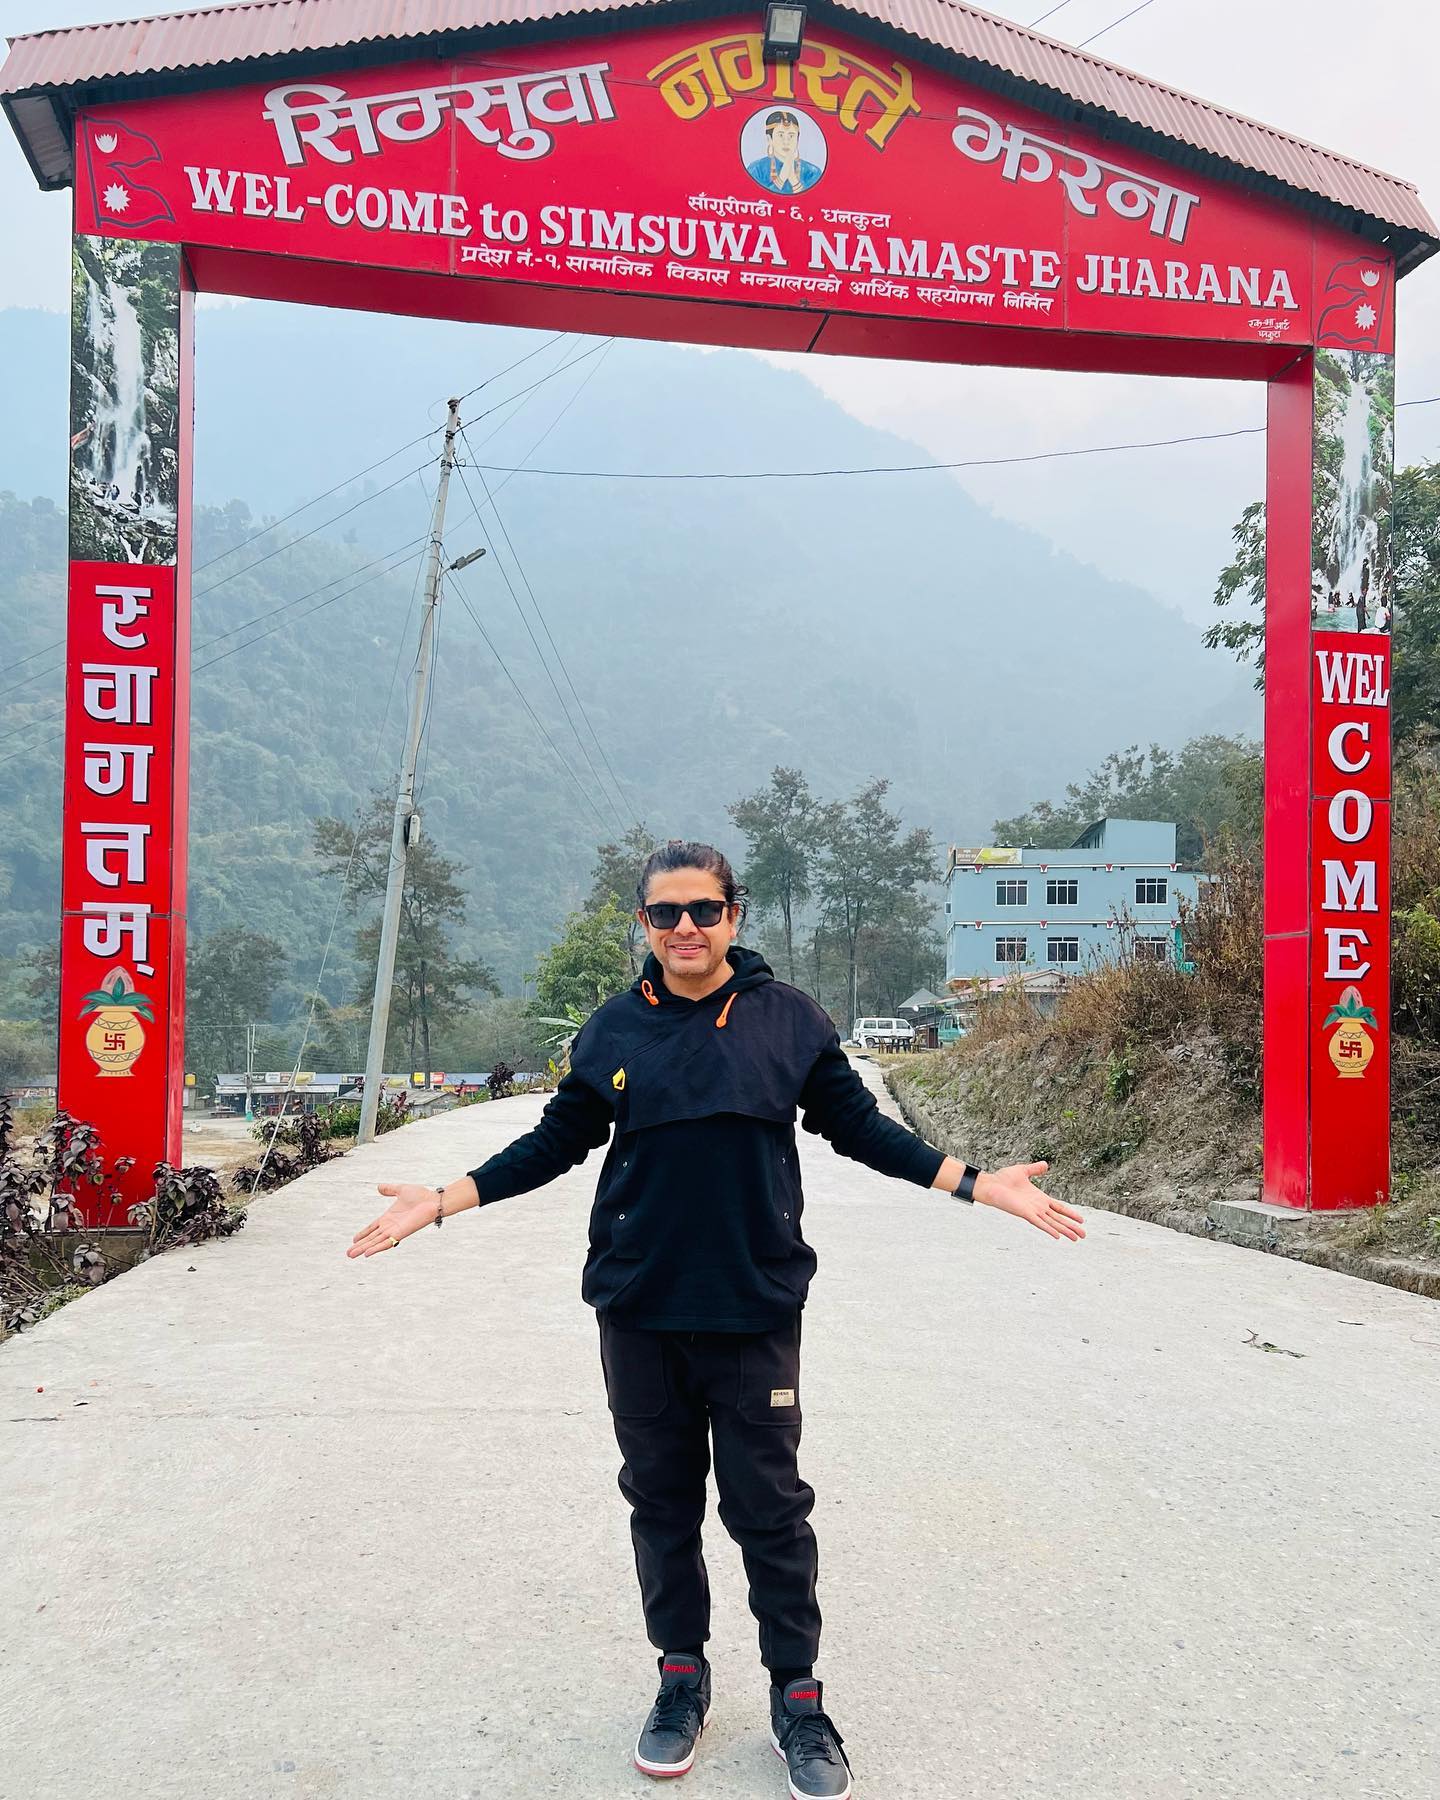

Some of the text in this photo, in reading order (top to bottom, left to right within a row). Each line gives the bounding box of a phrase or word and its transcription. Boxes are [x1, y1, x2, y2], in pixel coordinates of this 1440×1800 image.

[646, 33, 921, 150] नमस्ते
[952, 106, 1200, 243] झरना
[183, 166, 1299, 310] WEL-COME to SIMSUWA NAMASTE JHARANA
[821, 208, 891, 231] धनकुटा
[461, 243, 512, 268] प्रदेश
[565, 255, 655, 278] सामाजिक
[666, 261, 731, 286] विकास
[740, 273, 842, 294] मन्त्रालयको
[850, 279, 910, 300] आर्थिक
[917, 285, 995, 308] सहयोगमा
